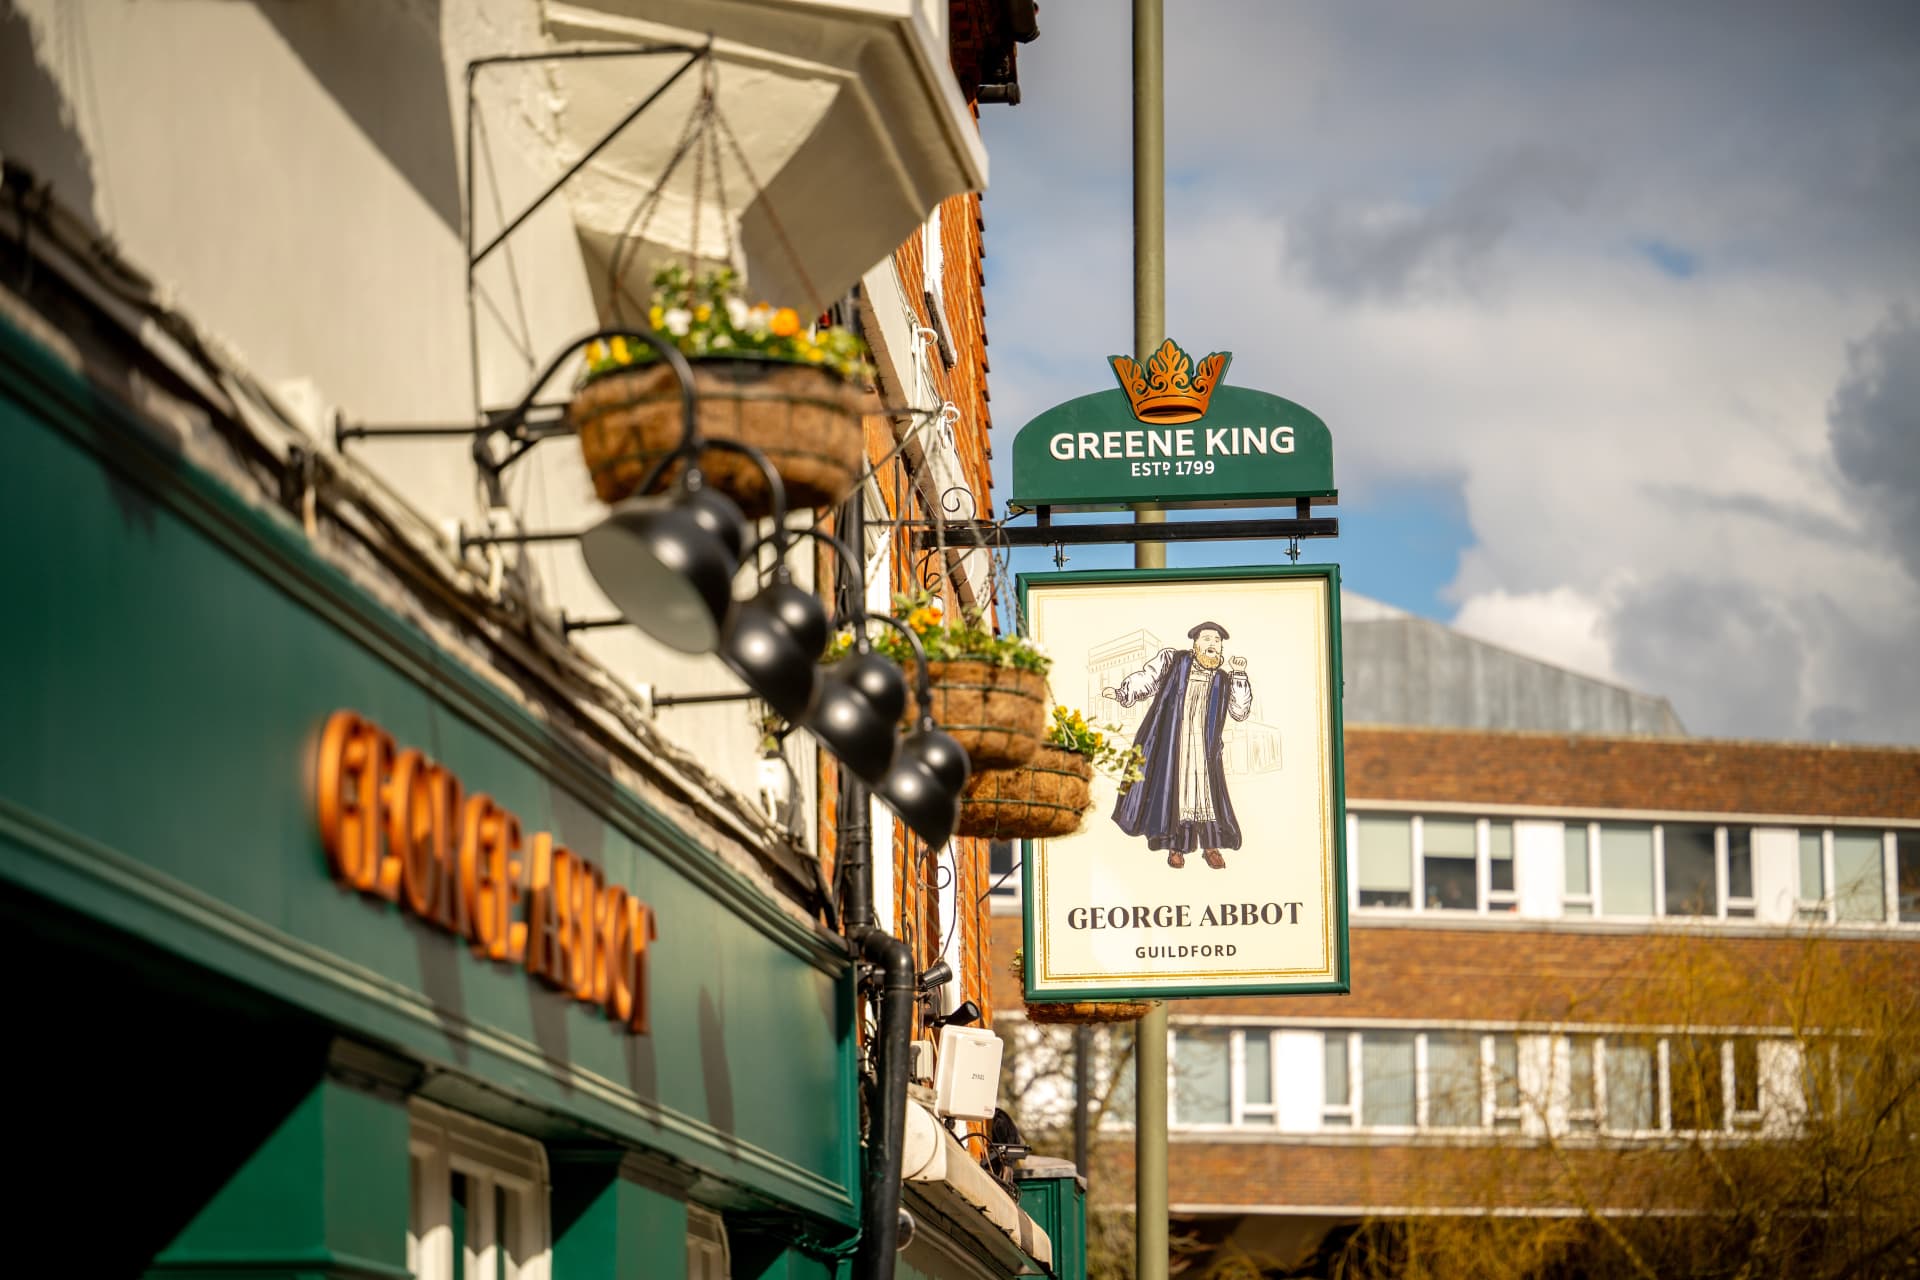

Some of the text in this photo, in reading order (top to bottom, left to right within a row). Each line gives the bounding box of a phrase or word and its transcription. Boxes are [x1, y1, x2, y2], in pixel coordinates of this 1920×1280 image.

[1049, 426, 1296, 461] GREENE KING
[1175, 460, 1215, 476] 1799
[1067, 901, 1304, 930] GEORGE ABBOT
[1135, 944, 1238, 959] GUILDFORD
